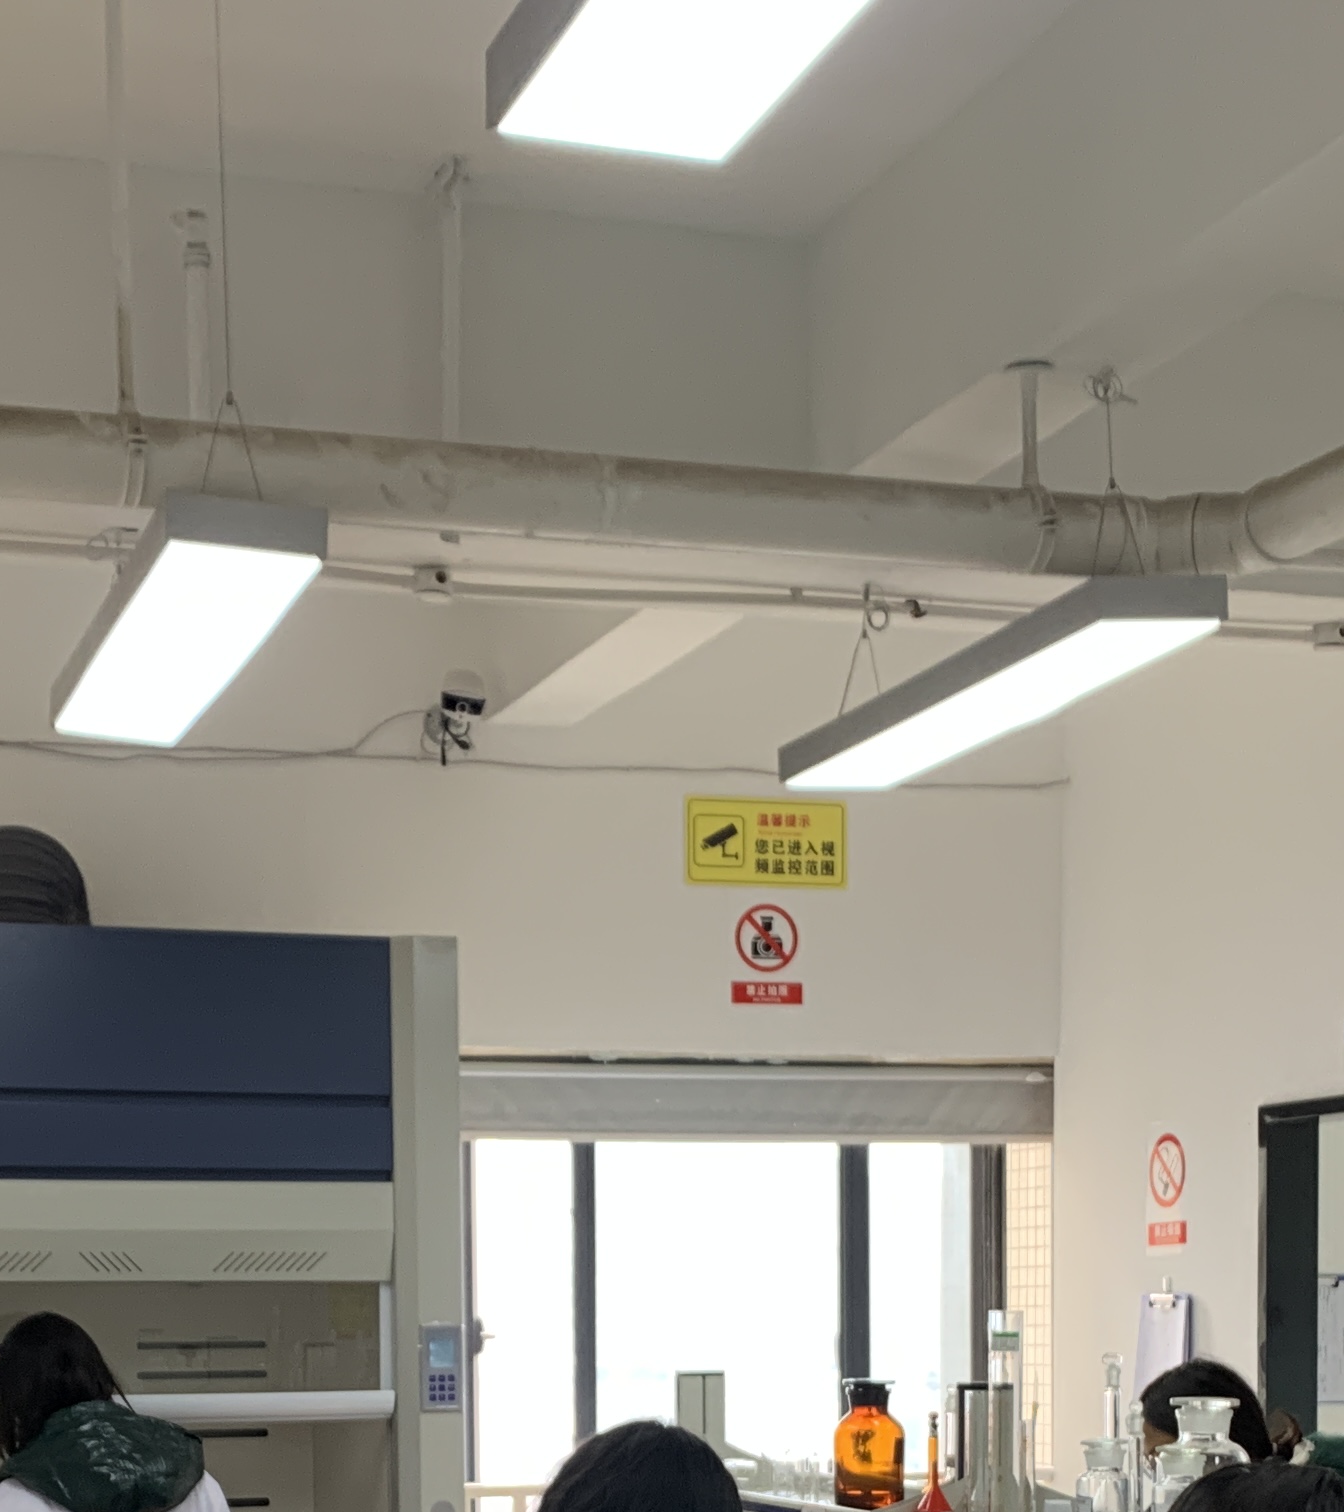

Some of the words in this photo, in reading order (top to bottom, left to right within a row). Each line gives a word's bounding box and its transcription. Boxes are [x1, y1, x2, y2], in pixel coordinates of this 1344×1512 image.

[755, 838, 835, 856] 您已进入视
[755, 858, 835, 876] 频监控范围
